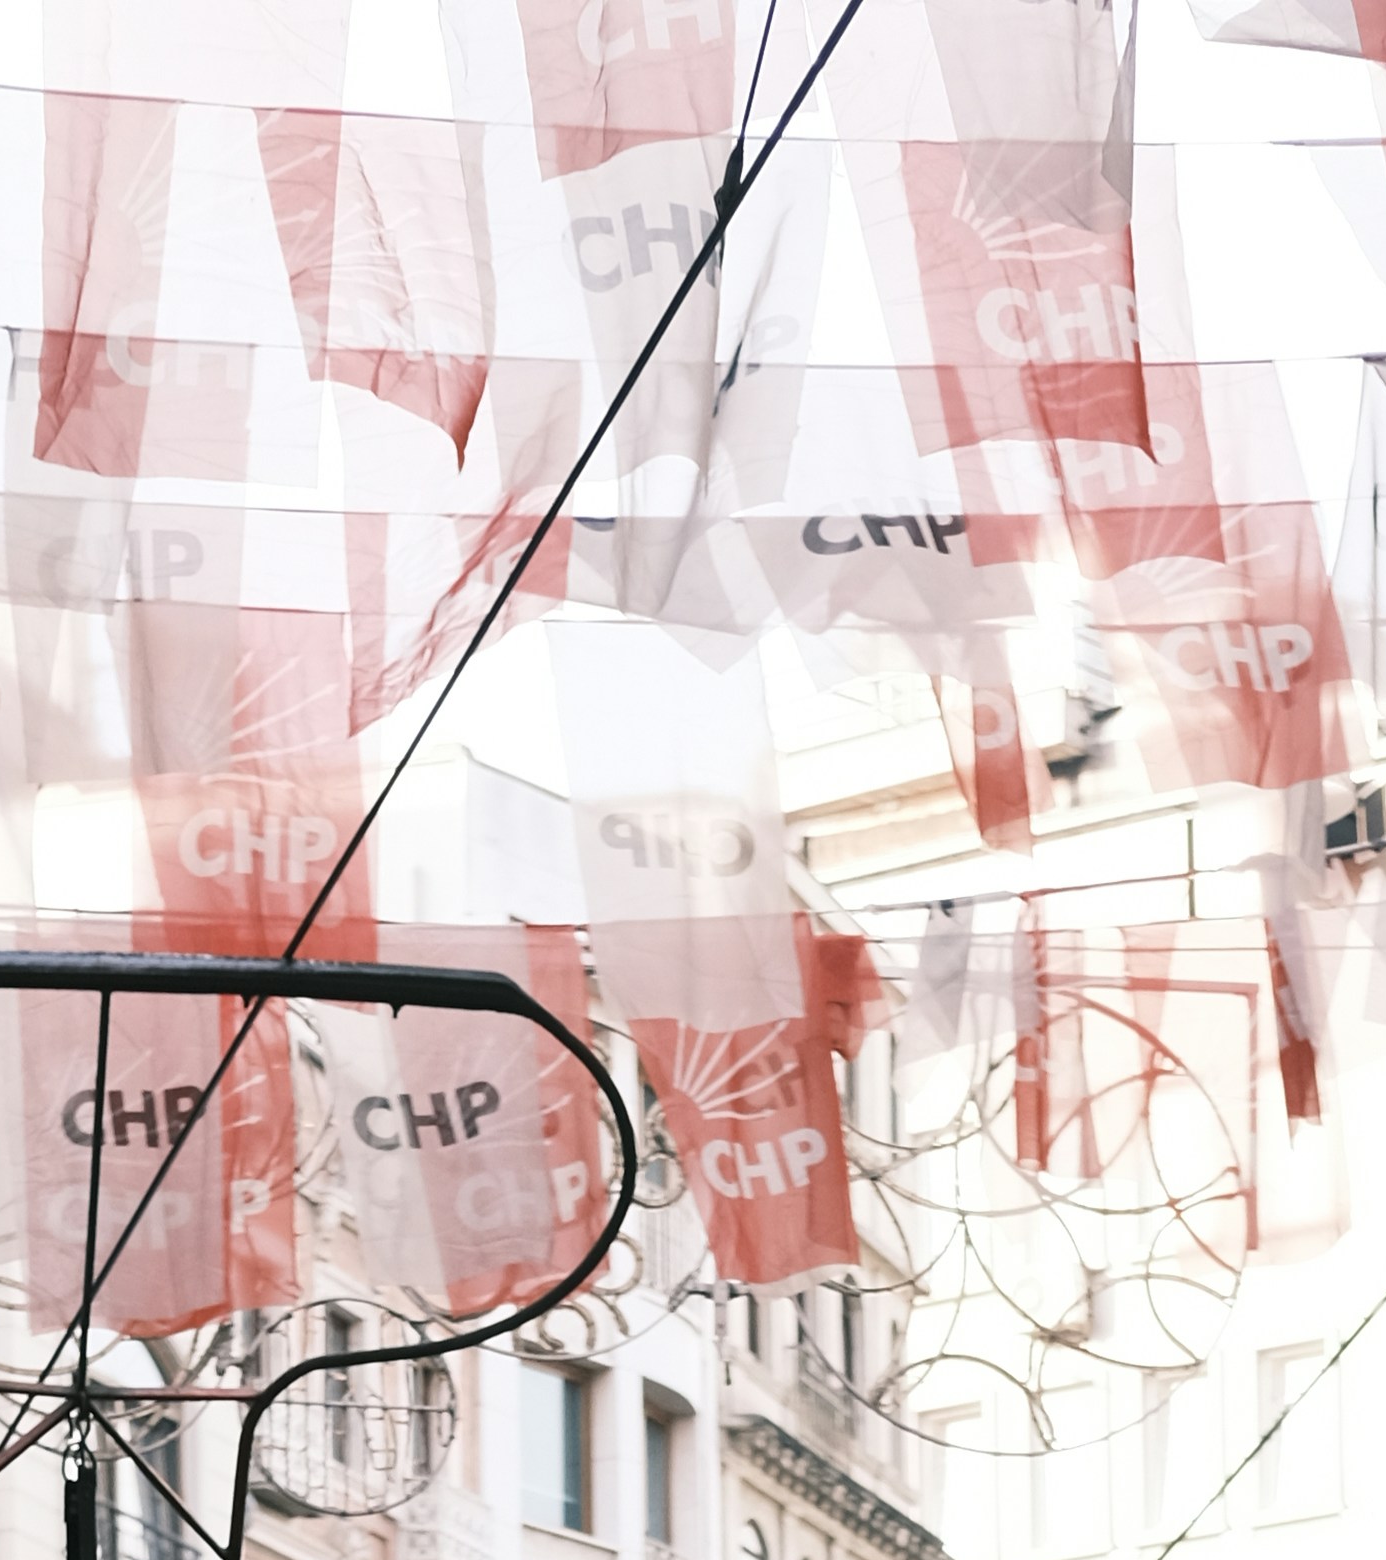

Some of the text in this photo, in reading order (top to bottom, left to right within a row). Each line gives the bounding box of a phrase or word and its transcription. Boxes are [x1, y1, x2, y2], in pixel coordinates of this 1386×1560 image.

[1158, 623, 1313, 695] CHP
[180, 806, 340, 884] CHP
[61, 1085, 211, 1150] CHP
[353, 1080, 501, 1149] CHP
[700, 1127, 830, 1200] CHP
